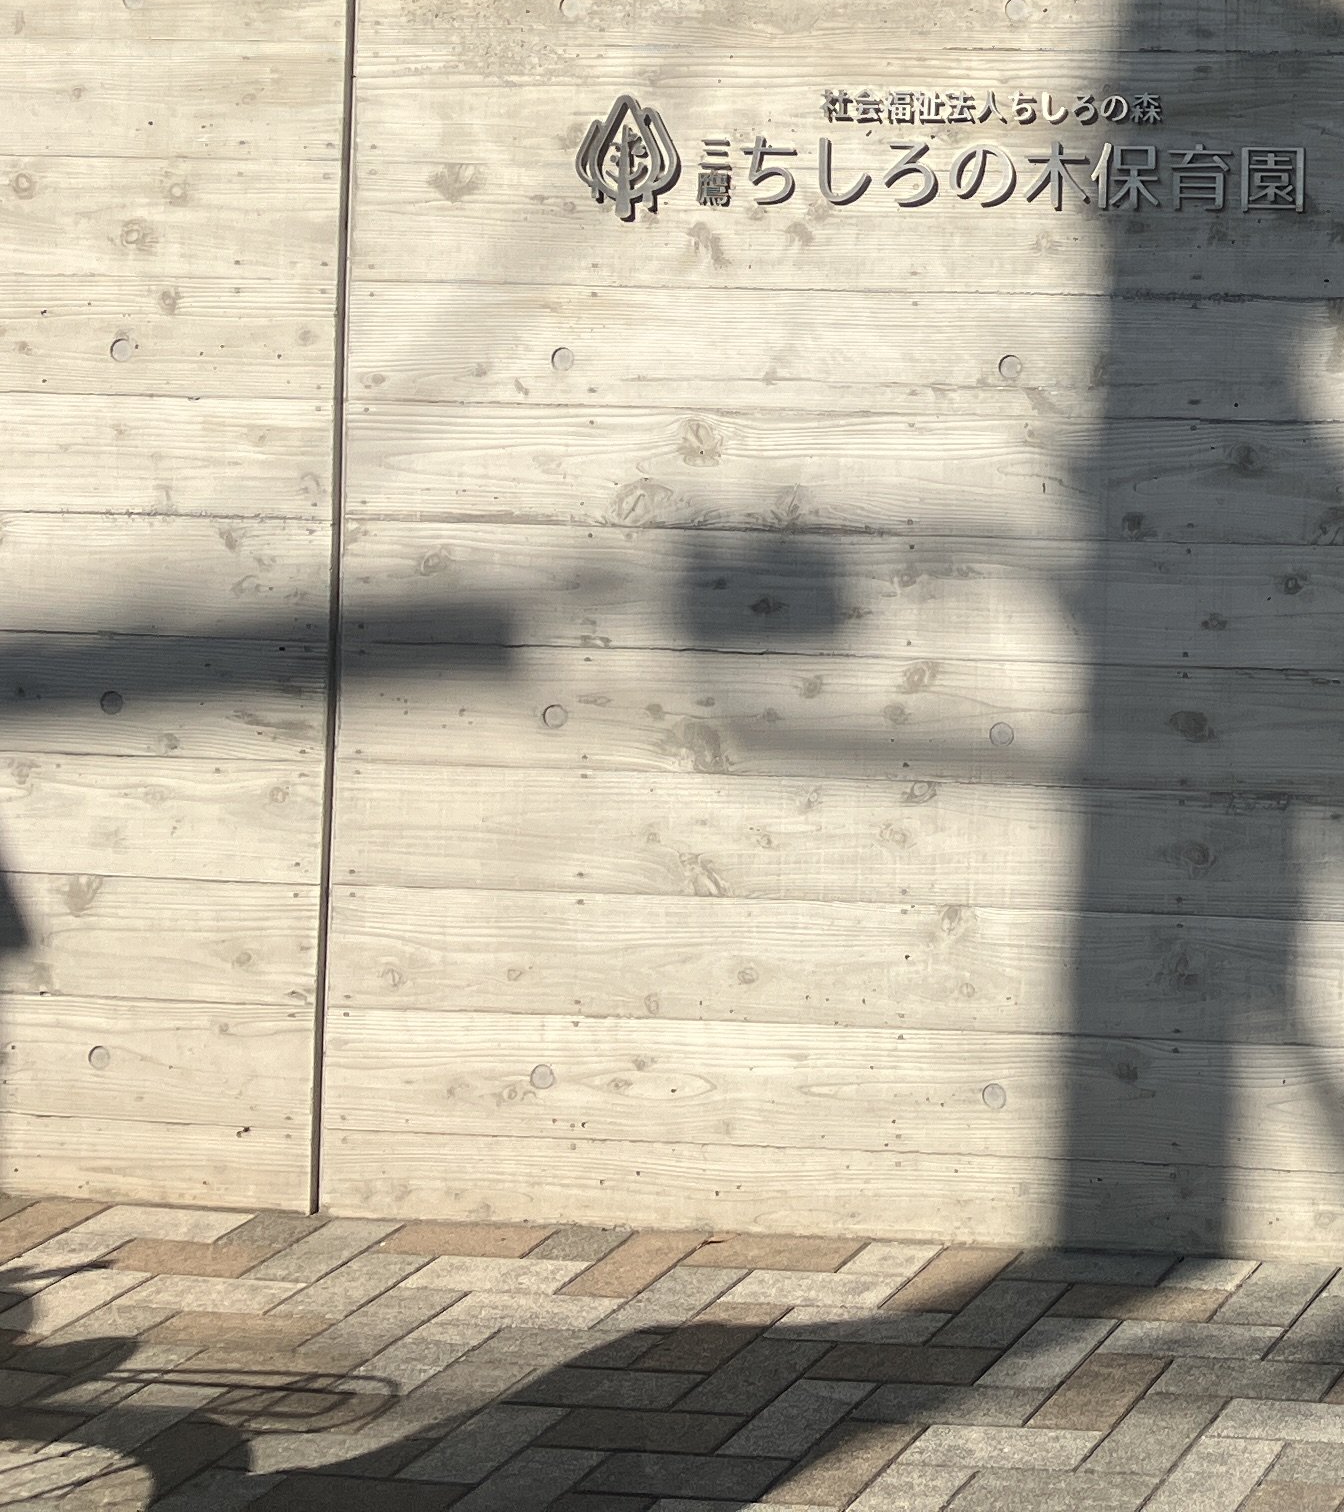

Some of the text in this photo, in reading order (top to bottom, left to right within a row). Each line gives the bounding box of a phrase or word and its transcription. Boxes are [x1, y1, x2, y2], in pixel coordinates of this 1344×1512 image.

[822, 88, 1163, 125] 社会福祉法人ちしろの森
[740, 135, 1306, 213] ちしろの木保育園
